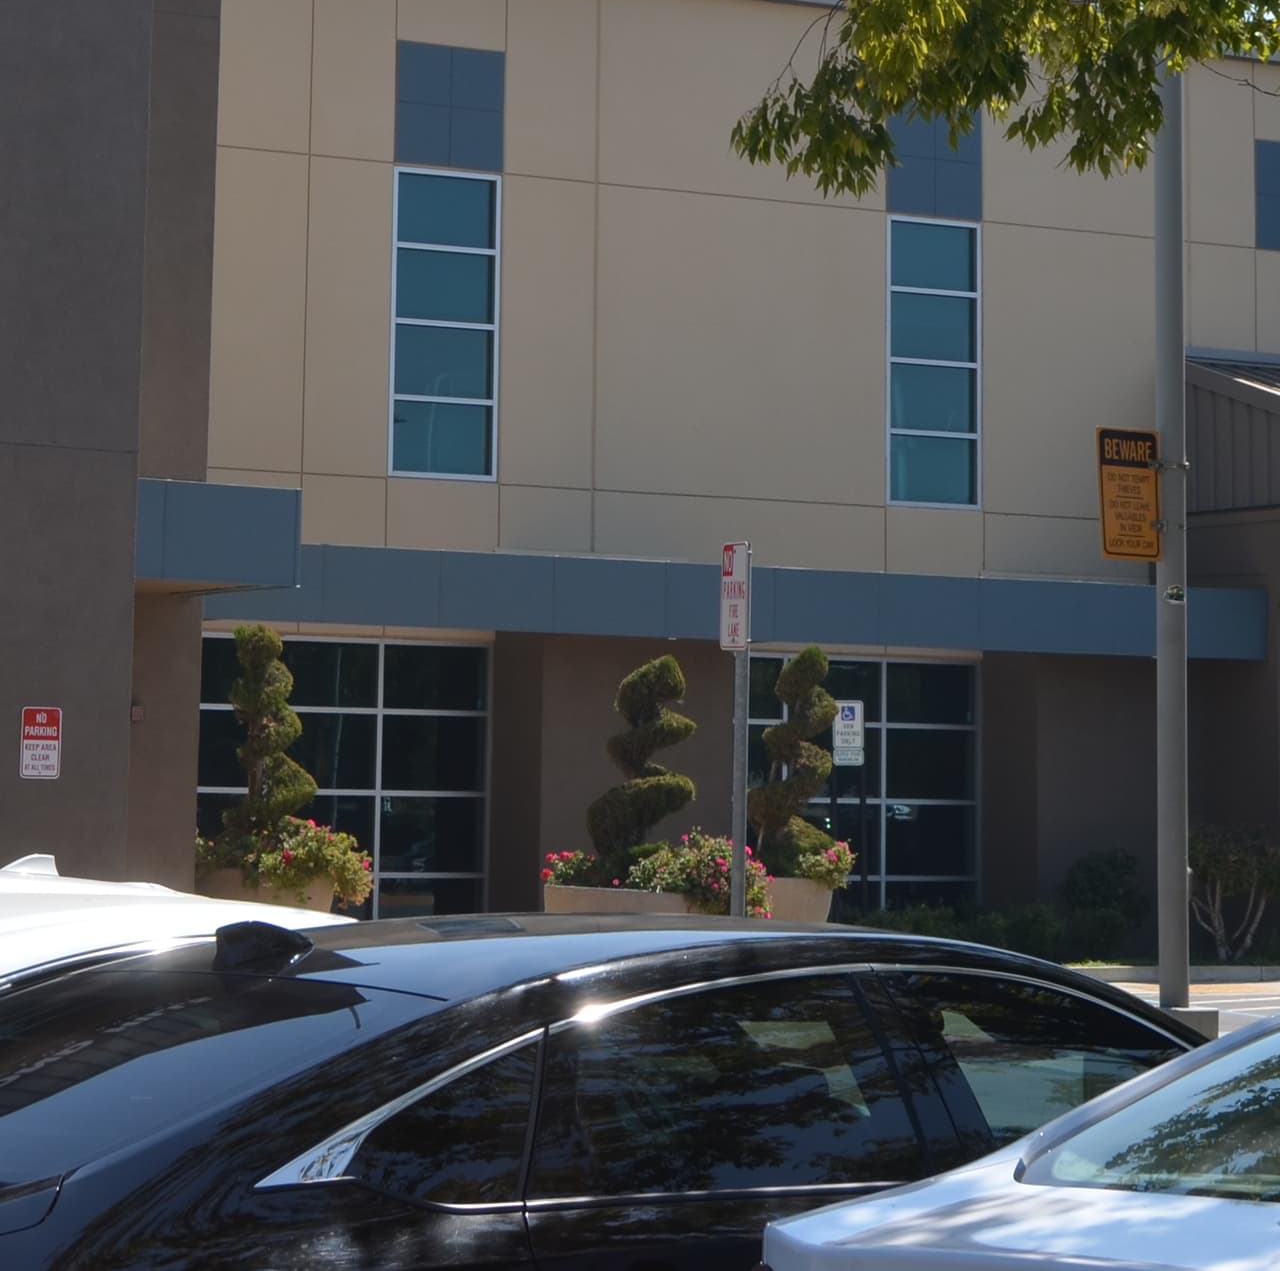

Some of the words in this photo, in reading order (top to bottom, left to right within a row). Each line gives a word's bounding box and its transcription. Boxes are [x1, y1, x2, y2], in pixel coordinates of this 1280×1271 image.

[1104, 438, 1153, 462] BEWARE
[723, 550, 733, 572] NO
[723, 581, 745, 599] PARKING
[36, 712, 47, 724] NO
[25, 726, 57, 736] PARKING
